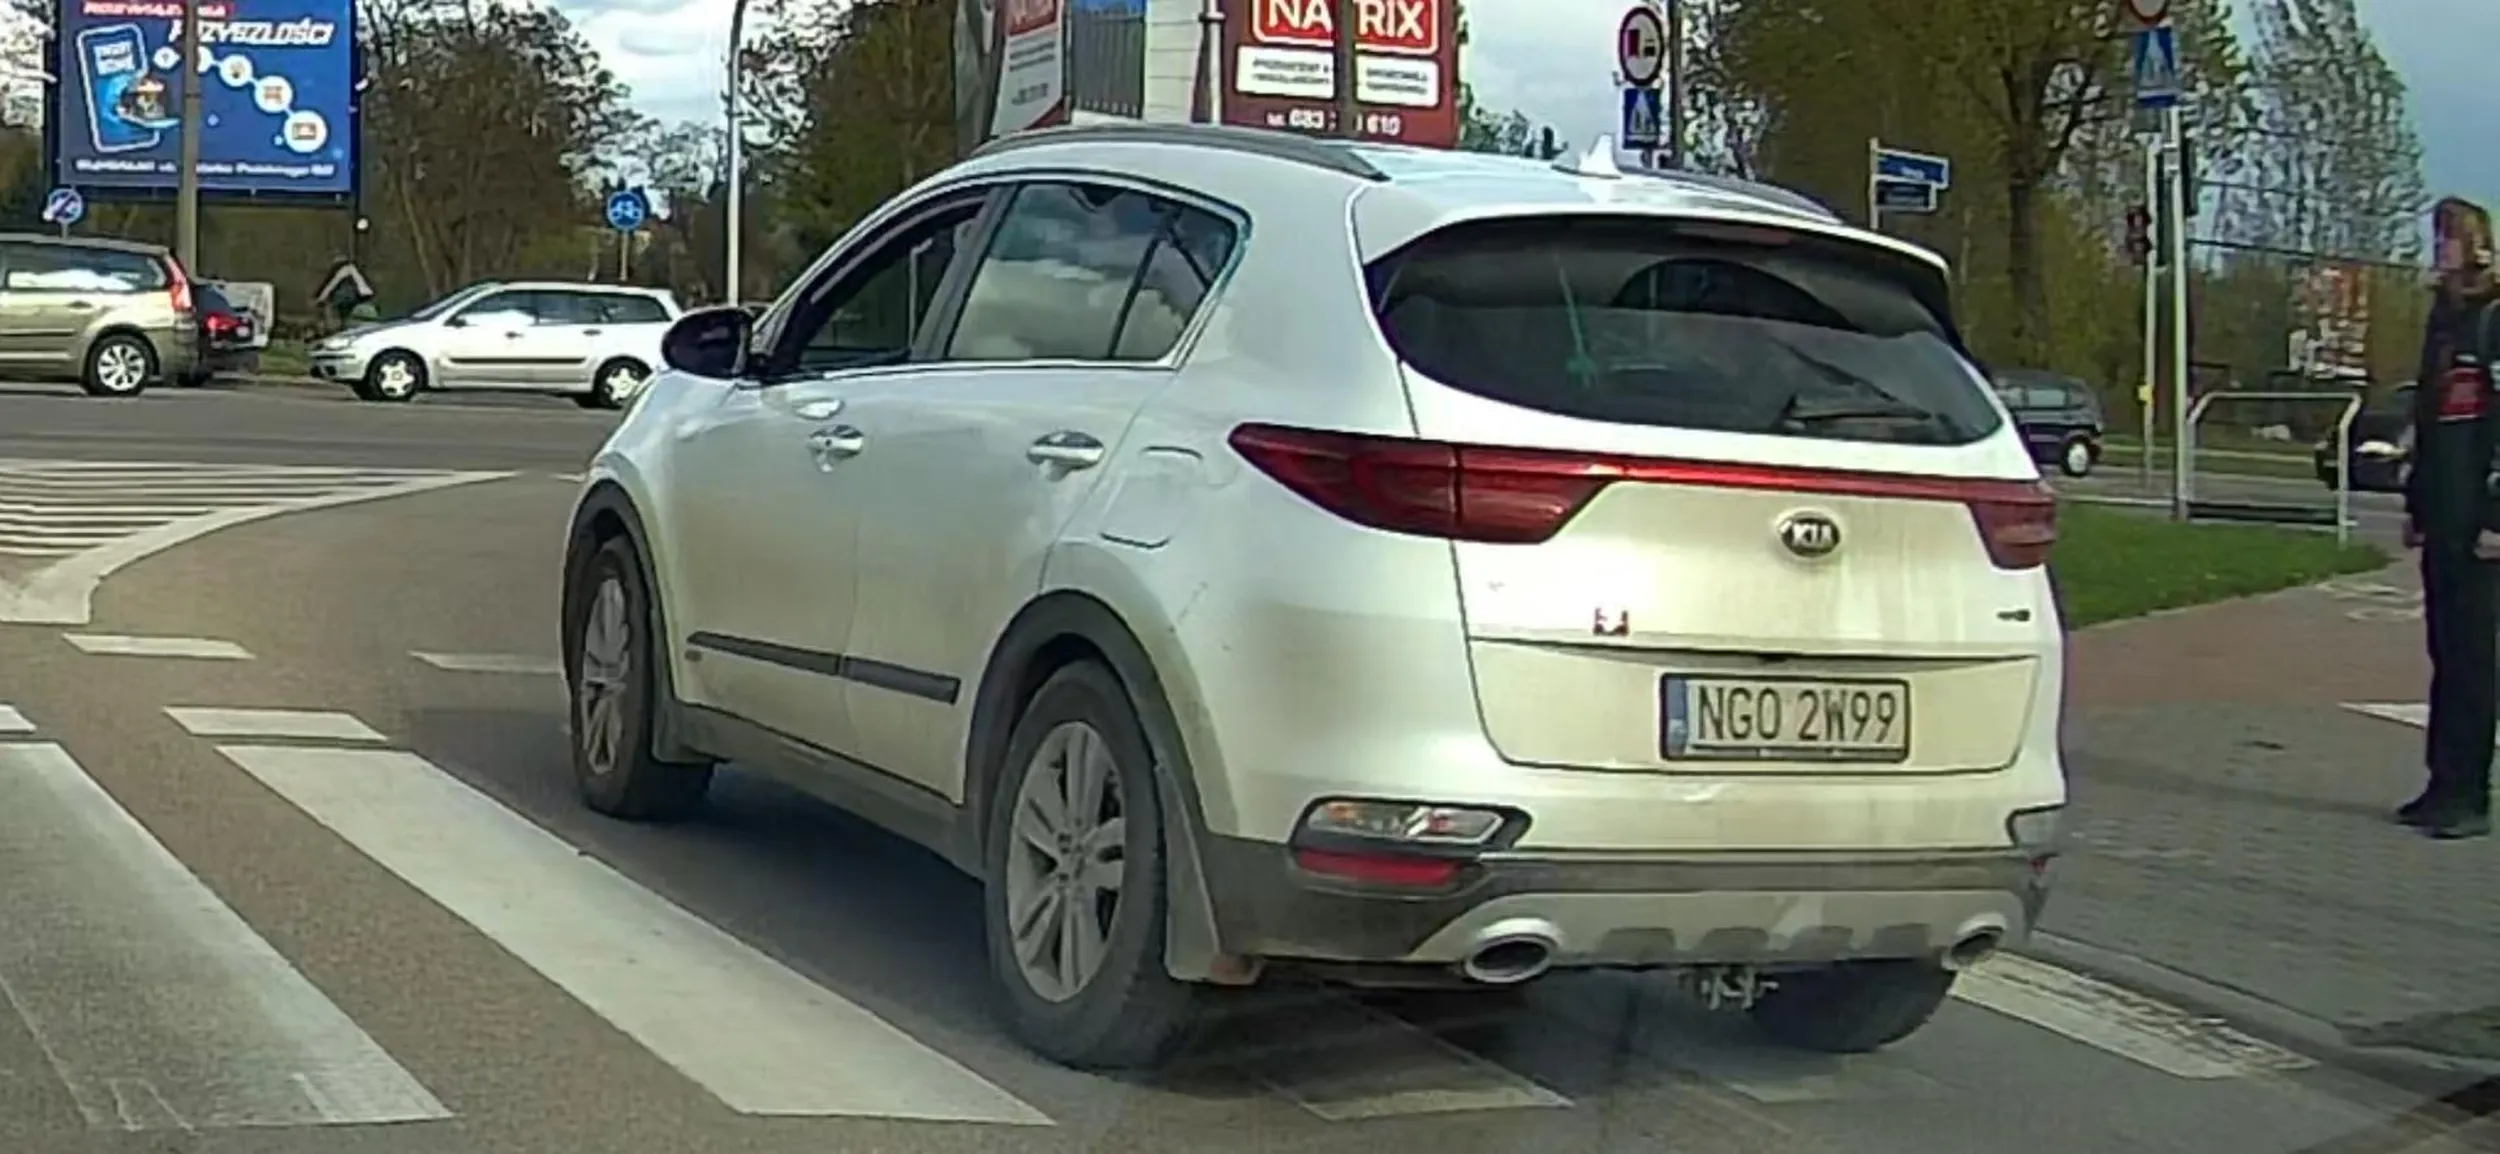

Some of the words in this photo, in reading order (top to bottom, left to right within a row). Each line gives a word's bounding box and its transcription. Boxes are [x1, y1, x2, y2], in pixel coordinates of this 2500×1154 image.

[167, 17, 335, 46] PZYSZŁOŚCI
[1267, 0, 1425, 40] NARIX
[1791, 522, 1833, 548] KIA
[1697, 685, 1783, 741] NGO
[1797, 688, 1898, 745] 2W99
